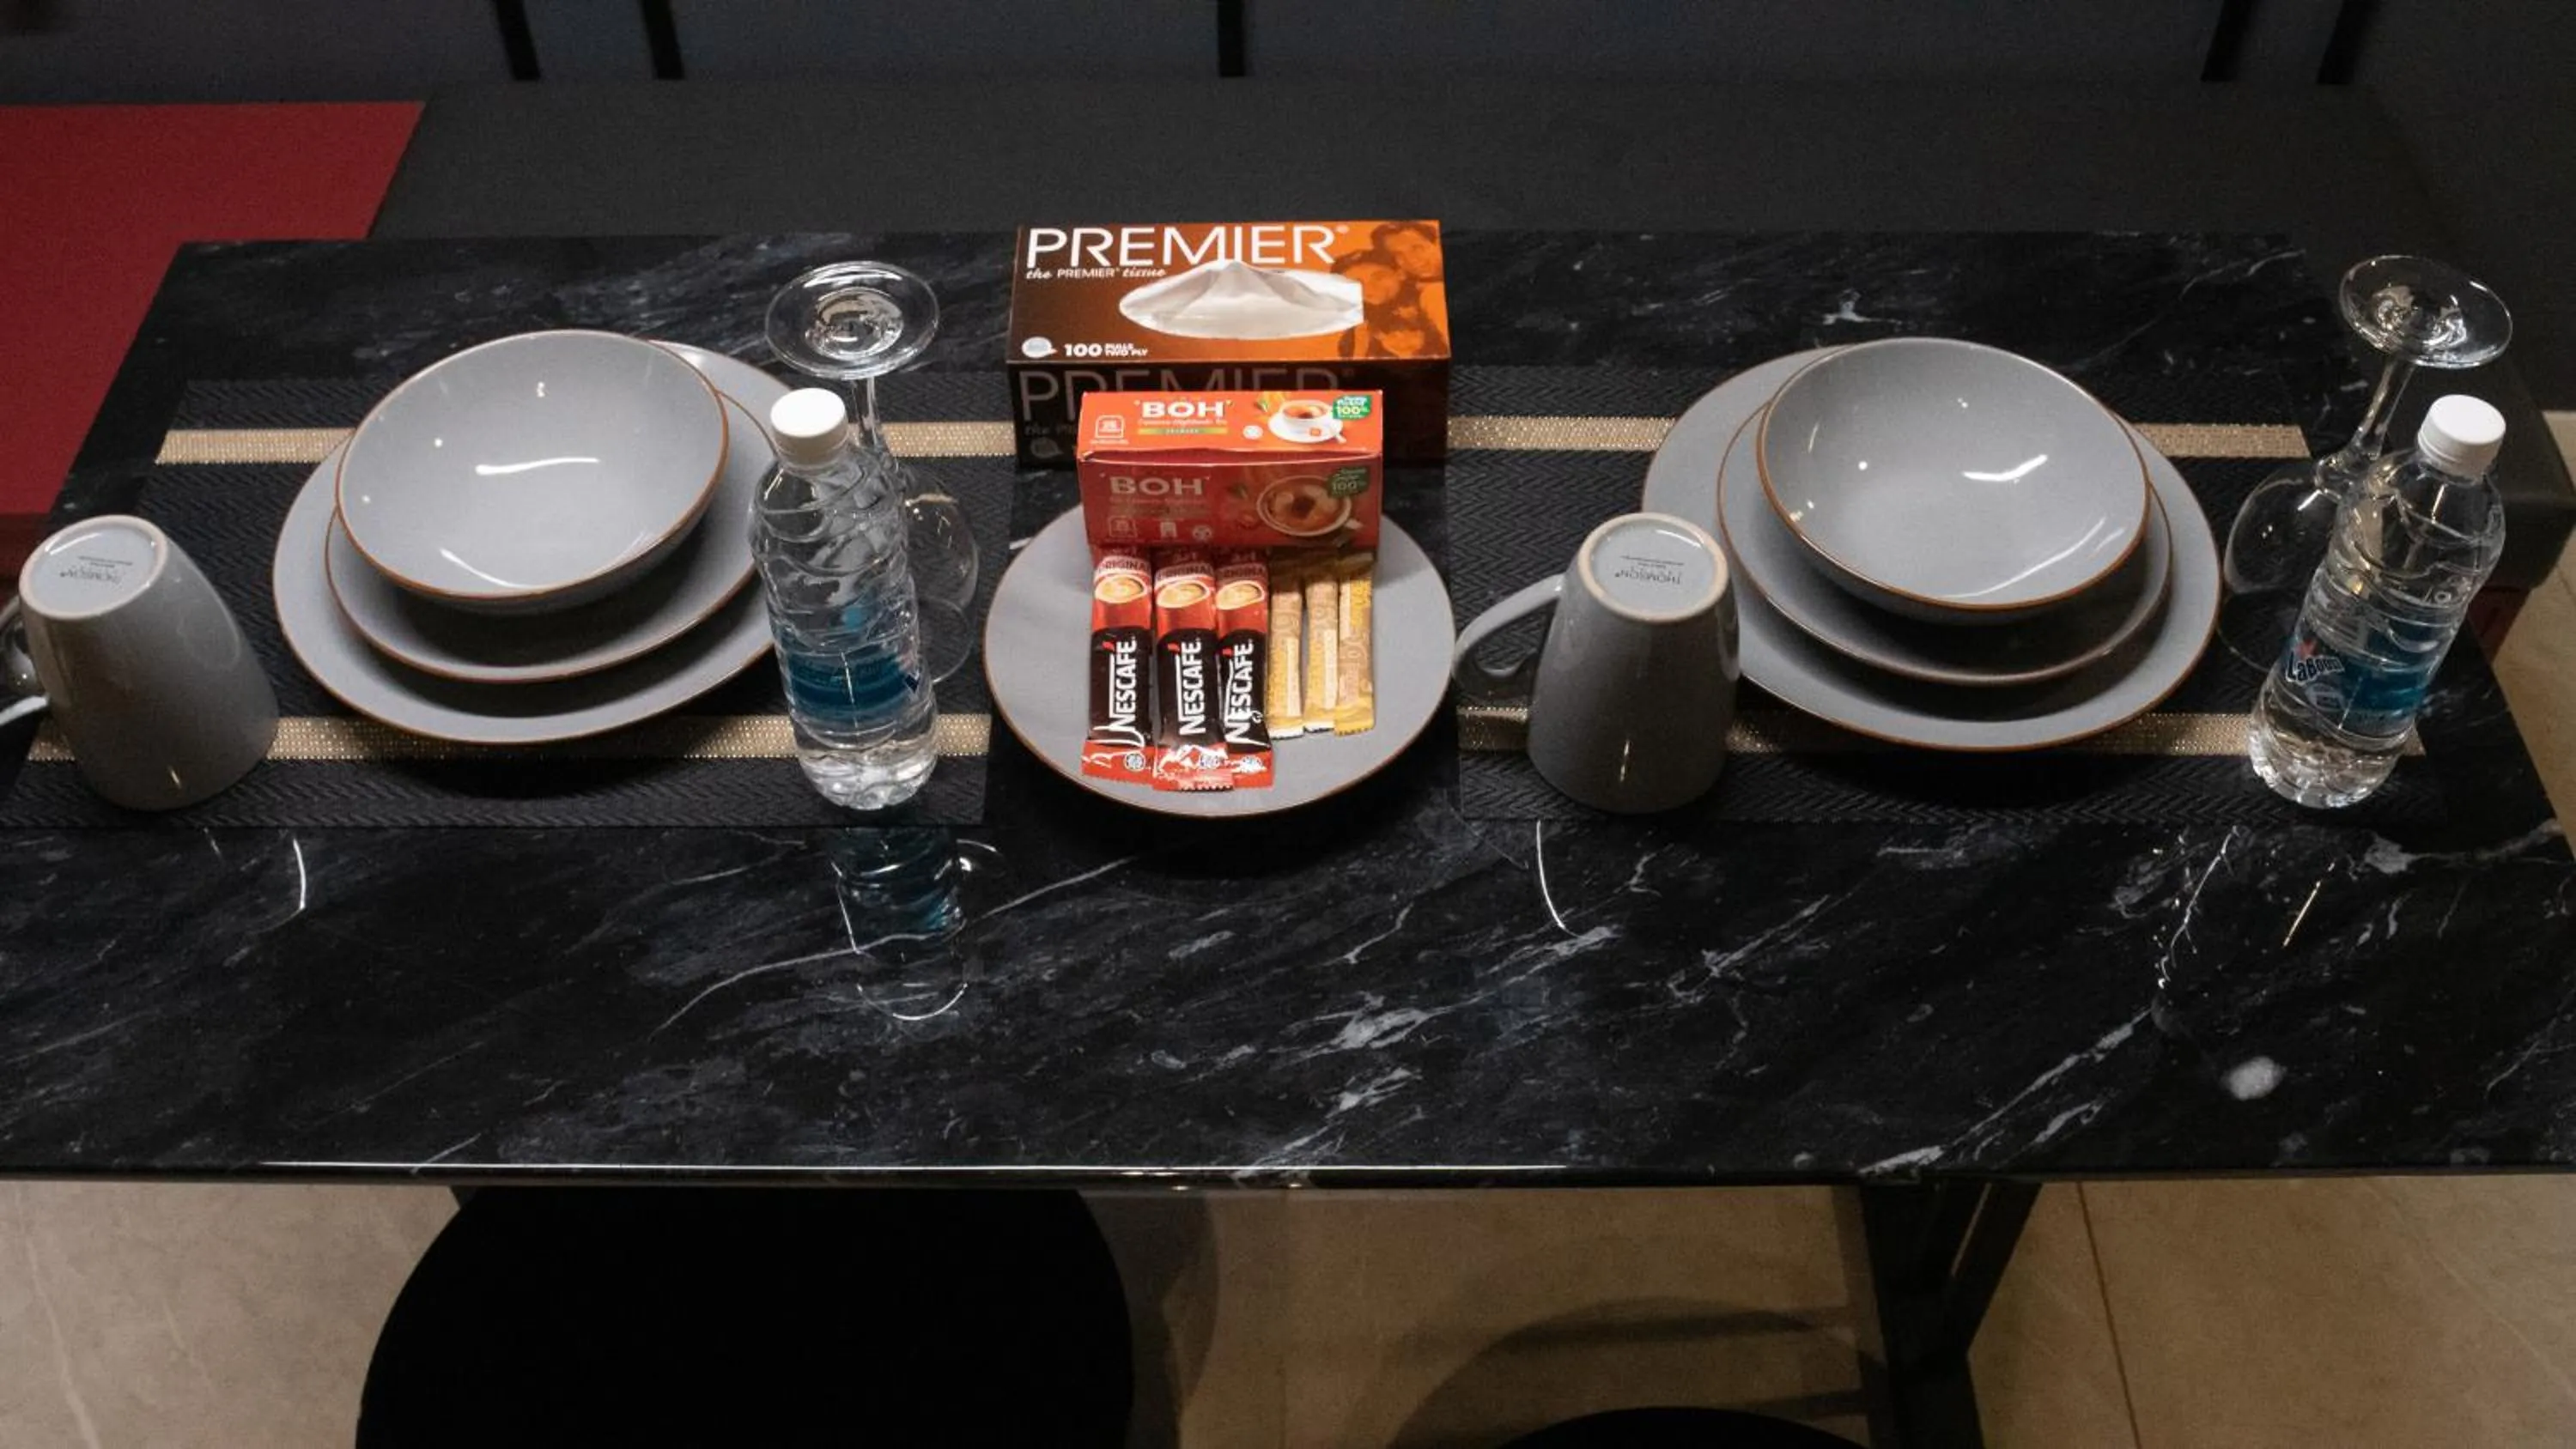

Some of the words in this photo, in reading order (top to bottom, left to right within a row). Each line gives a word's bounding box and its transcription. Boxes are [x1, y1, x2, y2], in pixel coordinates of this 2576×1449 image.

[1025, 225, 1339, 269] PREMIER
[1026, 268, 1053, 279] the
[1057, 267, 1116, 279] PREMIER
[1064, 343, 1103, 356] 100
[1141, 401, 1224, 418] BOH
[1109, 476, 1203, 496] BOH
